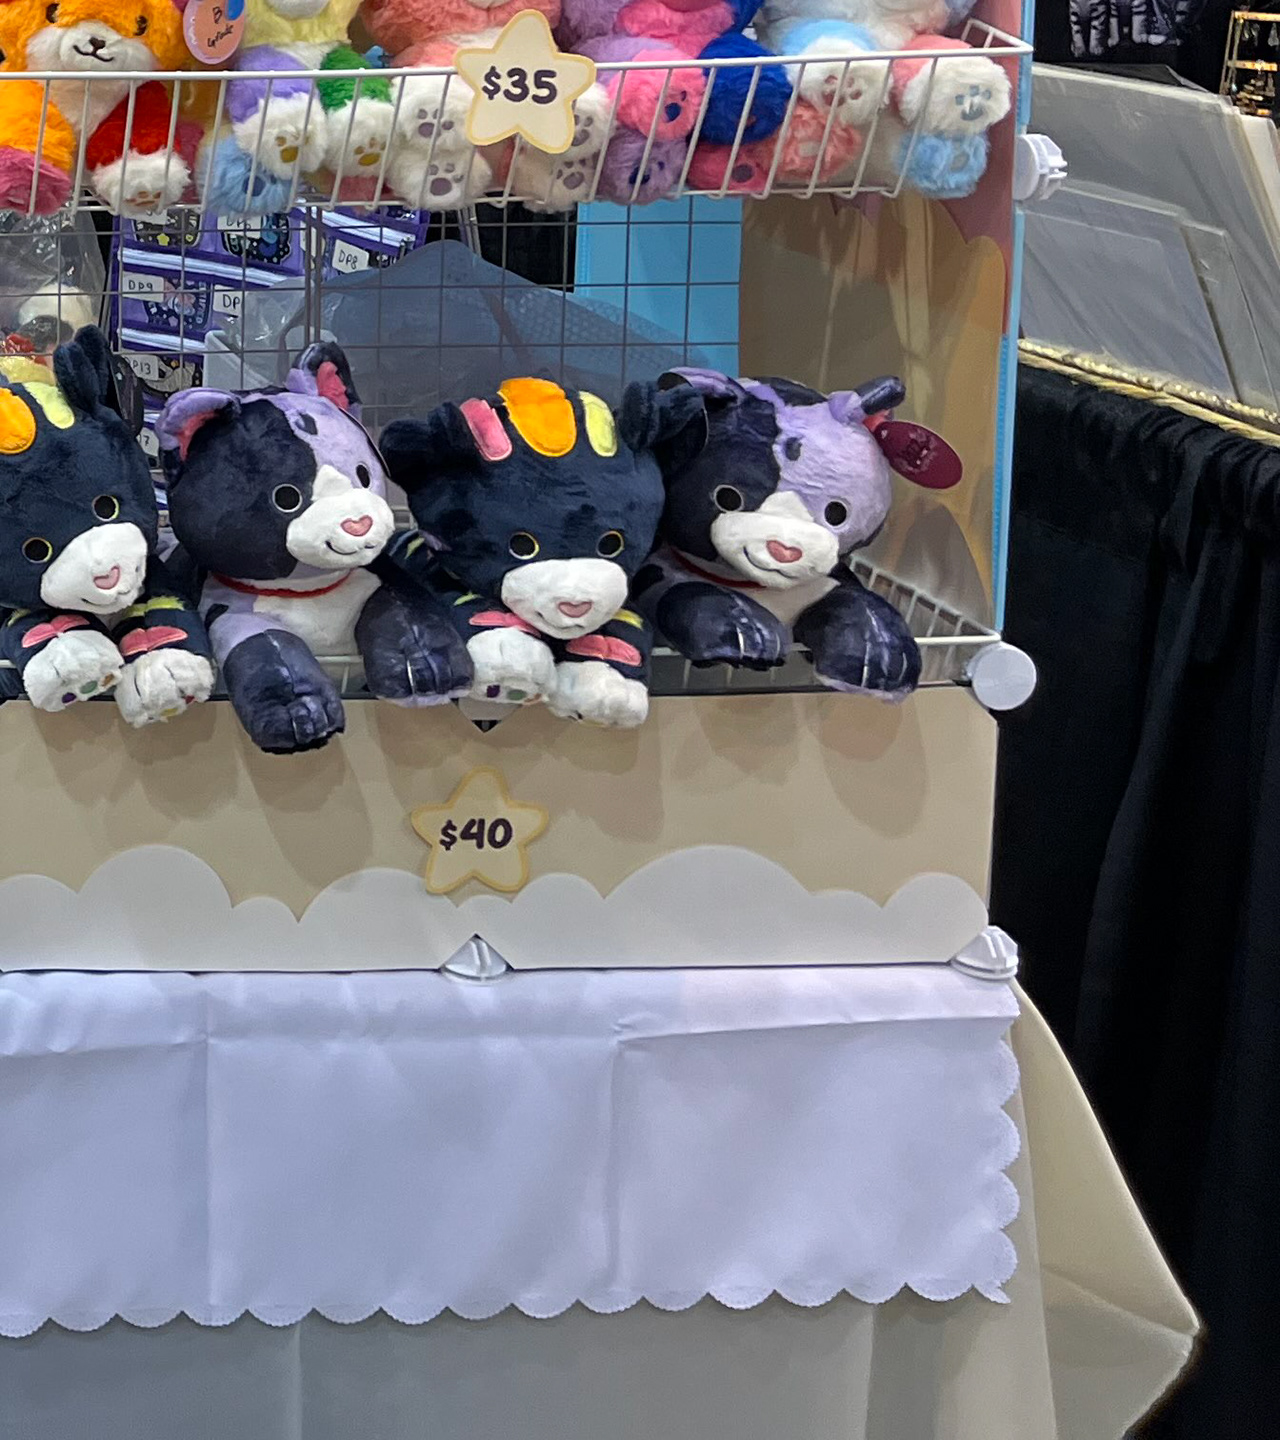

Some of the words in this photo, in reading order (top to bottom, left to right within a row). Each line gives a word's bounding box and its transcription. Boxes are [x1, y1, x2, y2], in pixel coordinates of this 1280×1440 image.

[213, 6, 223, 24] B
[481, 65, 558, 105] $35
[338, 250, 358, 269] DP8
[439, 817, 513, 852] $40
